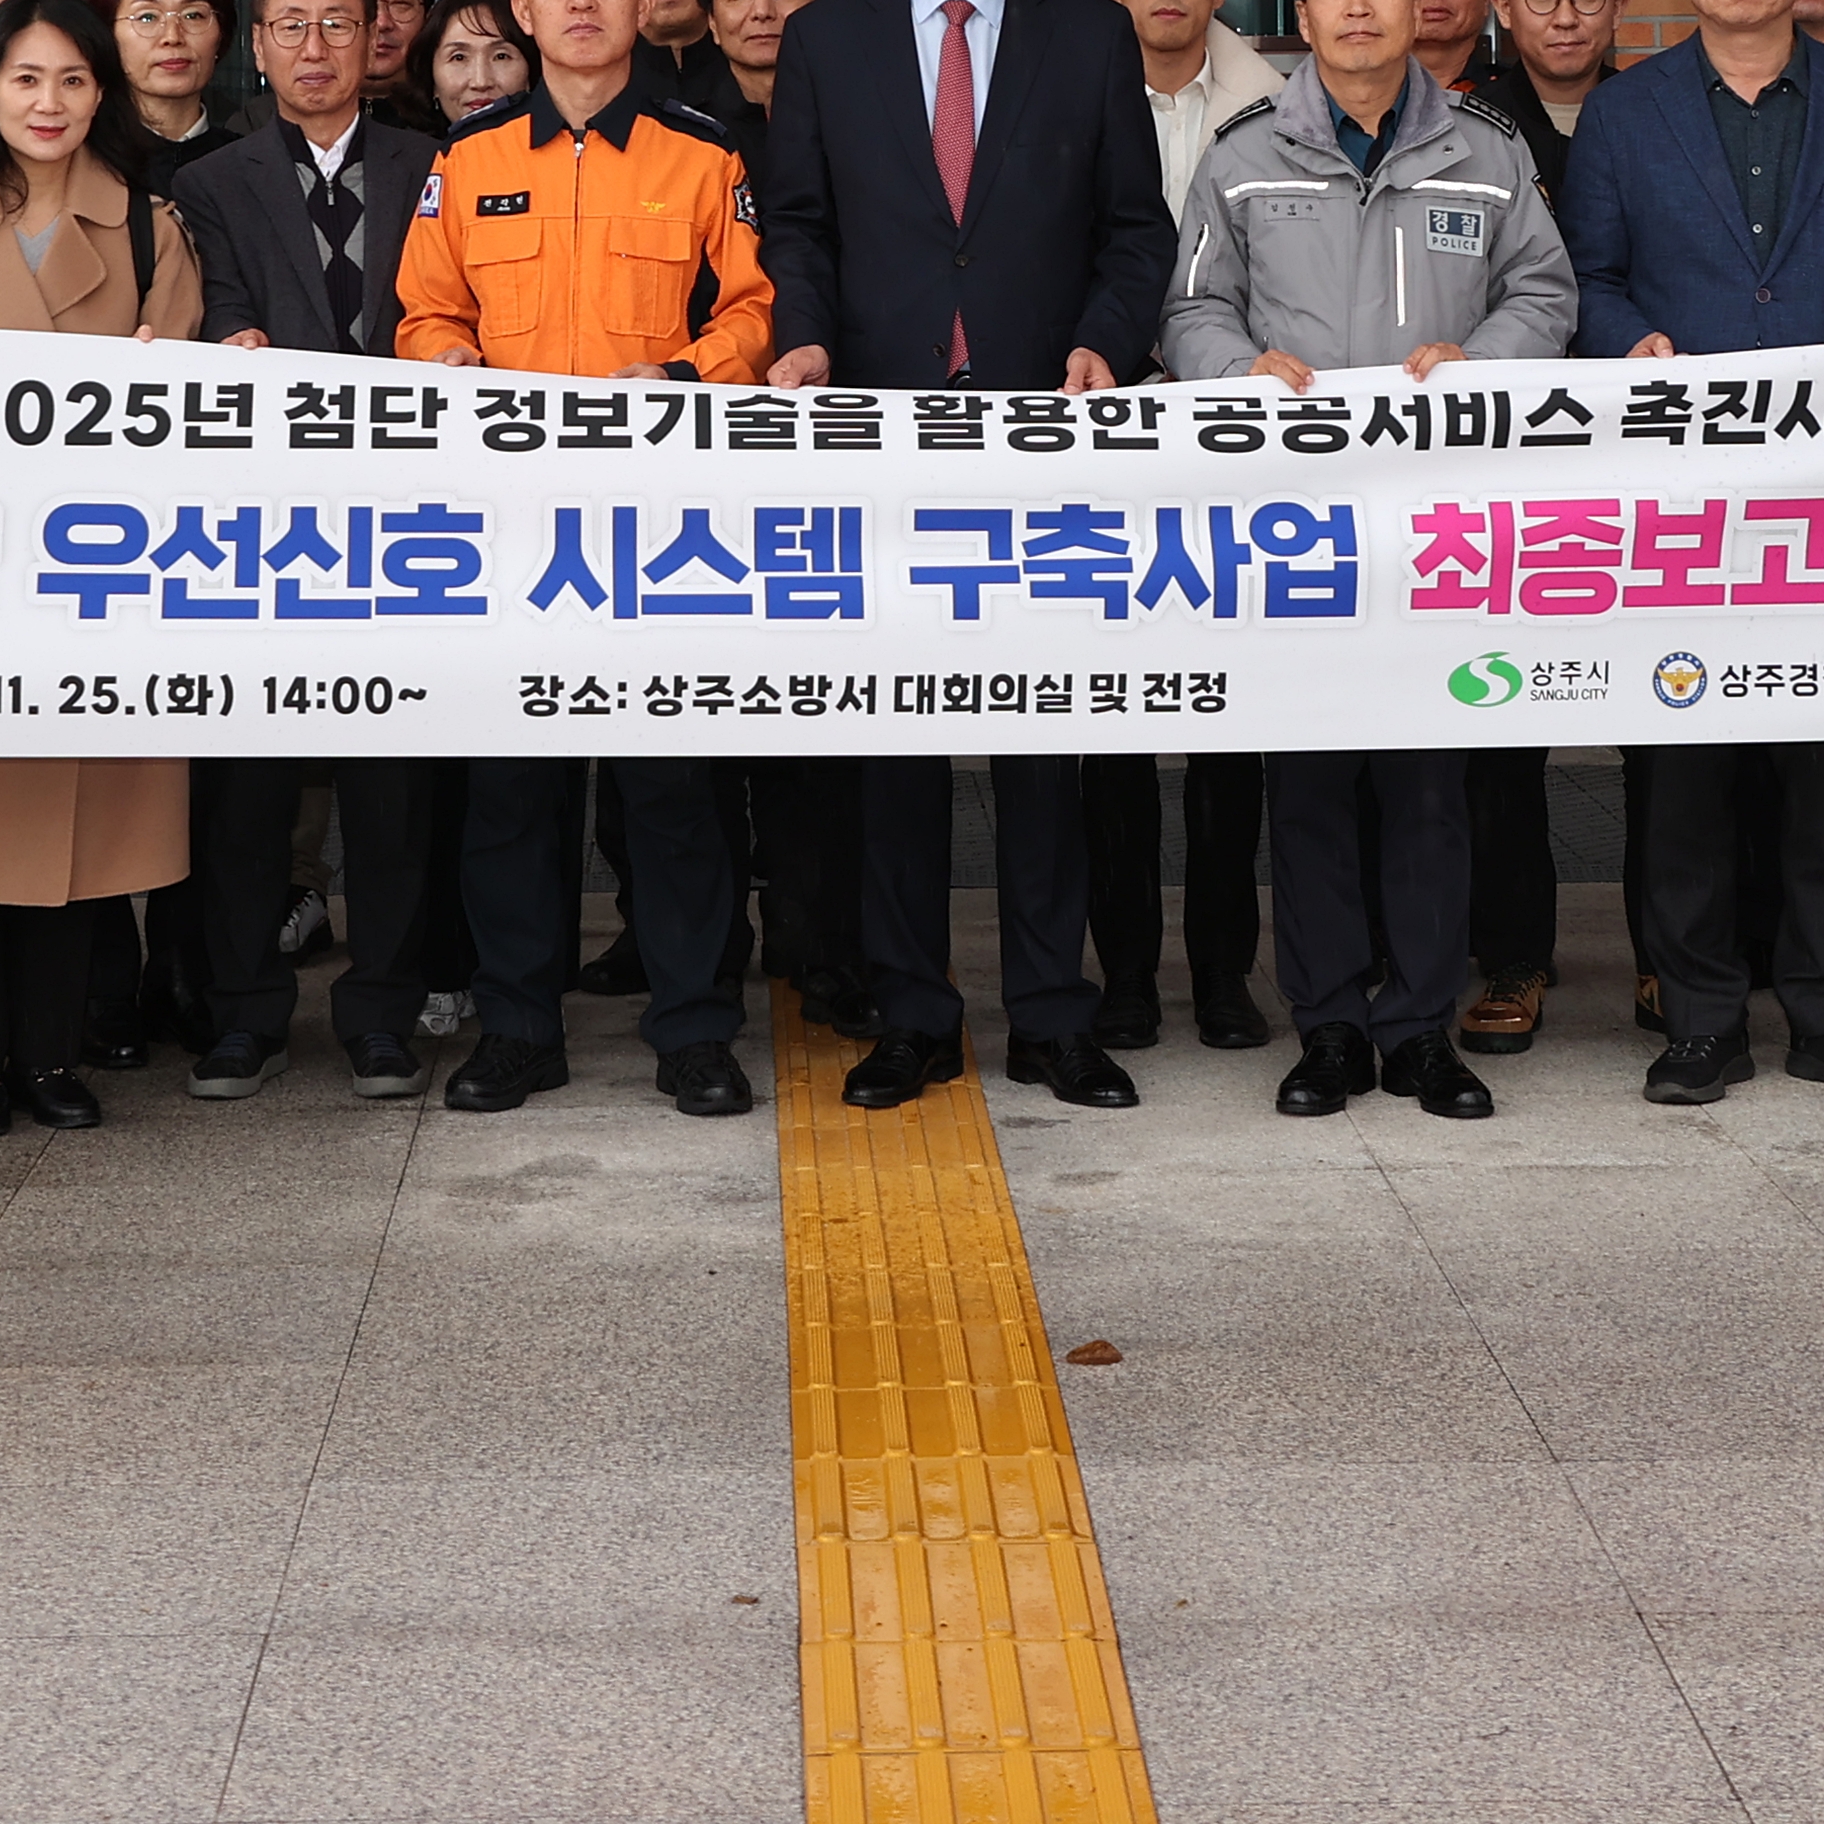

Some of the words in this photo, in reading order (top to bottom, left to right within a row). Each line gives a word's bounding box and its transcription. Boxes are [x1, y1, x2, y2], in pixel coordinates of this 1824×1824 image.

[1432, 236, 1477, 251] POLICE
[284, 381, 448, 450] 첨단
[473, 388, 885, 453] 정보기술을
[912, 394, 1166, 453] 활용한
[1192, 387, 1595, 454] 공공서비스
[36, 503, 488, 620] 우선신호
[526, 506, 865, 620] 시스템
[909, 501, 1358, 621] 구축사업
[1531, 660, 1610, 687] 상주시
[58, 673, 234, 717] 25.(화)
[263, 676, 428, 715] 14:00~
[519, 675, 627, 717] 장소:
[642, 674, 877, 717] 상주소방서
[893, 673, 1073, 715] 대회의실
[1089, 673, 1128, 714] 및
[1142, 672, 1227, 714] 전정
[1530, 688, 1579, 702] SANGJU
[1581, 687, 1609, 700] CITY
